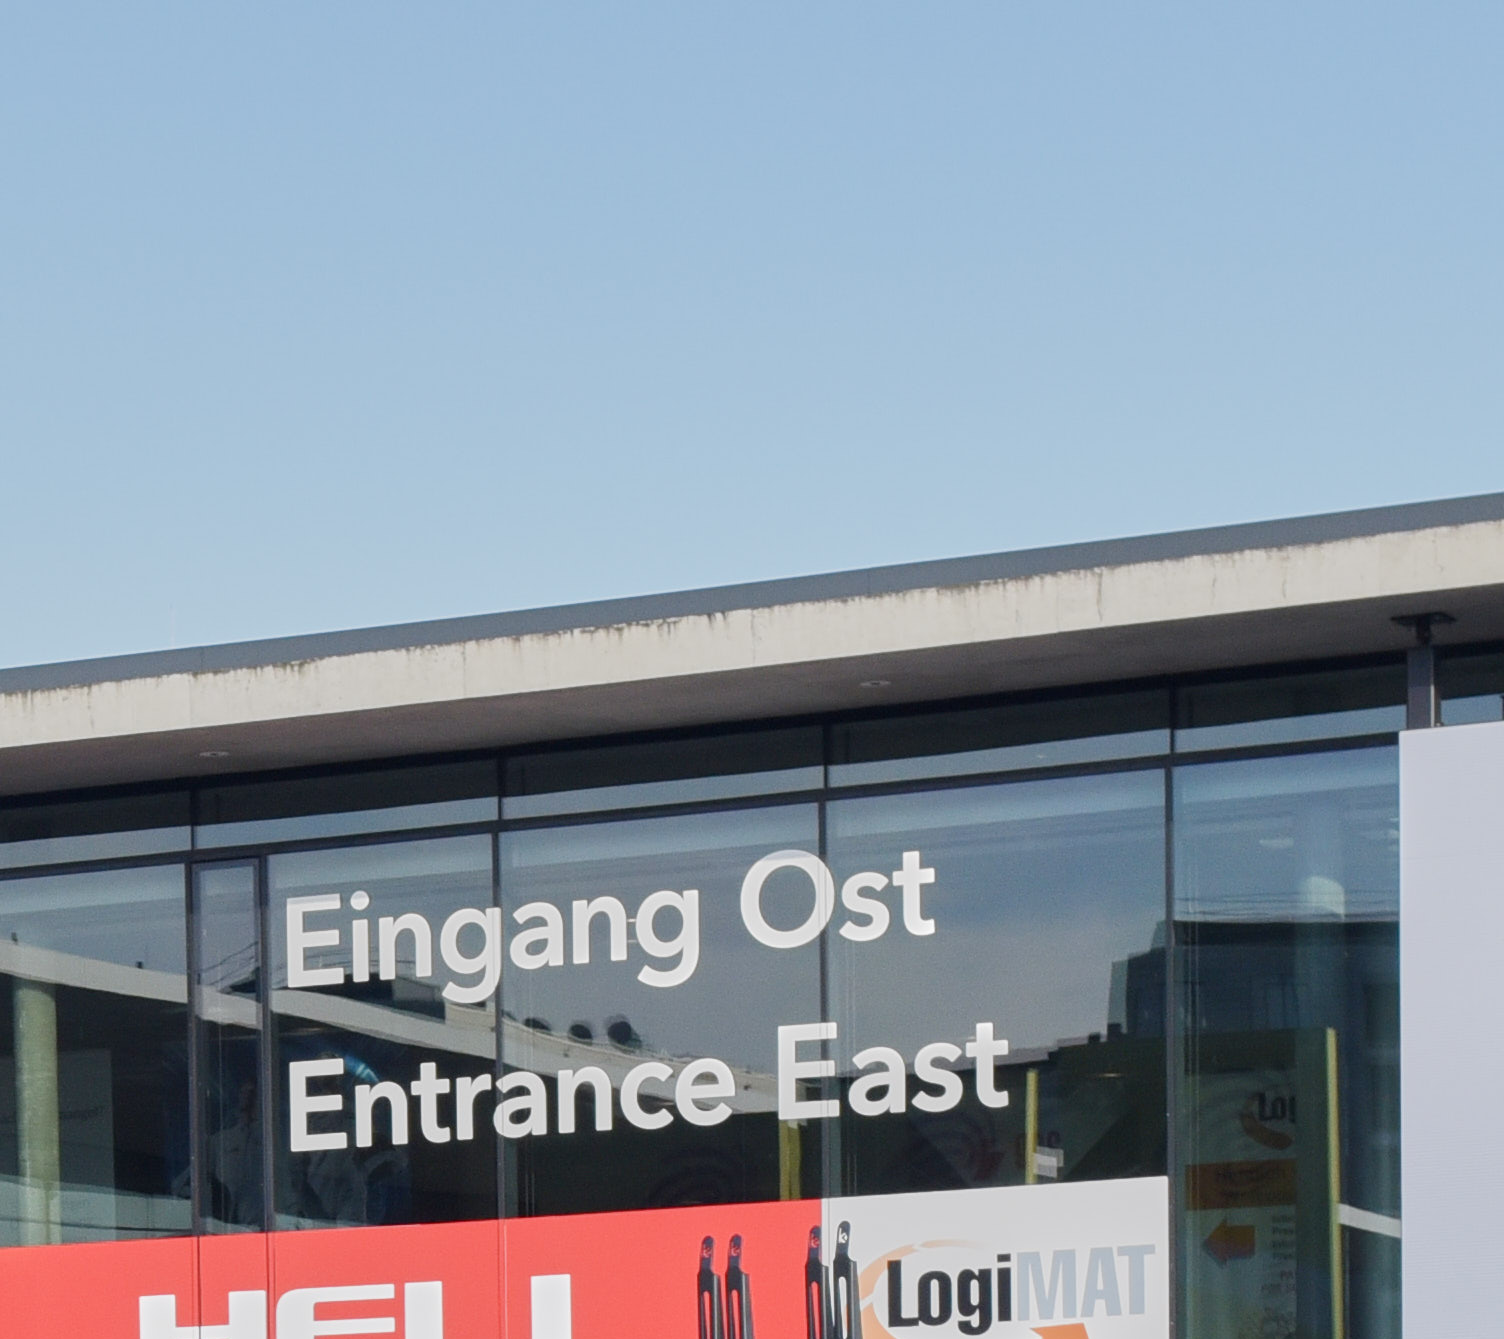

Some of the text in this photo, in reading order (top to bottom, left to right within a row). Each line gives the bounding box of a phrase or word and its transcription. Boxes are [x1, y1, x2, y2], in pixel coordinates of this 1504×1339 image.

[285, 849, 936, 1004] Eingang Ost
[289, 1021, 1010, 1153] Entrance East
[888, 1244, 1156, 1335] LogiMAT
